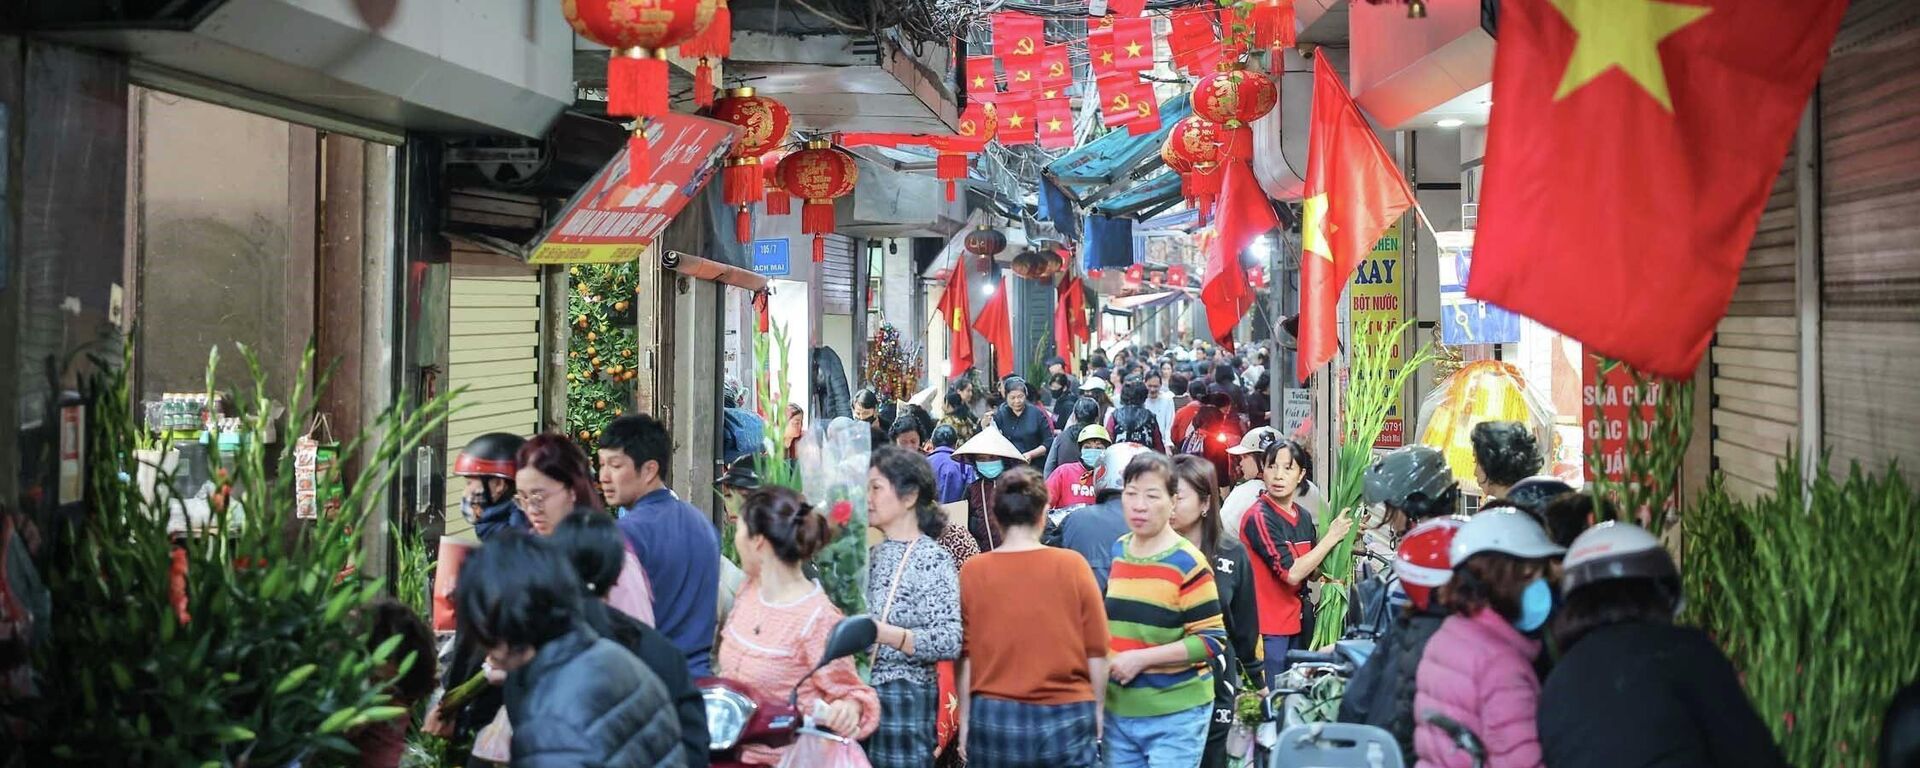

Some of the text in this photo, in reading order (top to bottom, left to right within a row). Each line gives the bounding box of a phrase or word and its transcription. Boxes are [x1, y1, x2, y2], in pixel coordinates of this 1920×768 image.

[1355, 259, 1396, 285] XAY
[1353, 292, 1398, 314] BỘT NƯỚC
